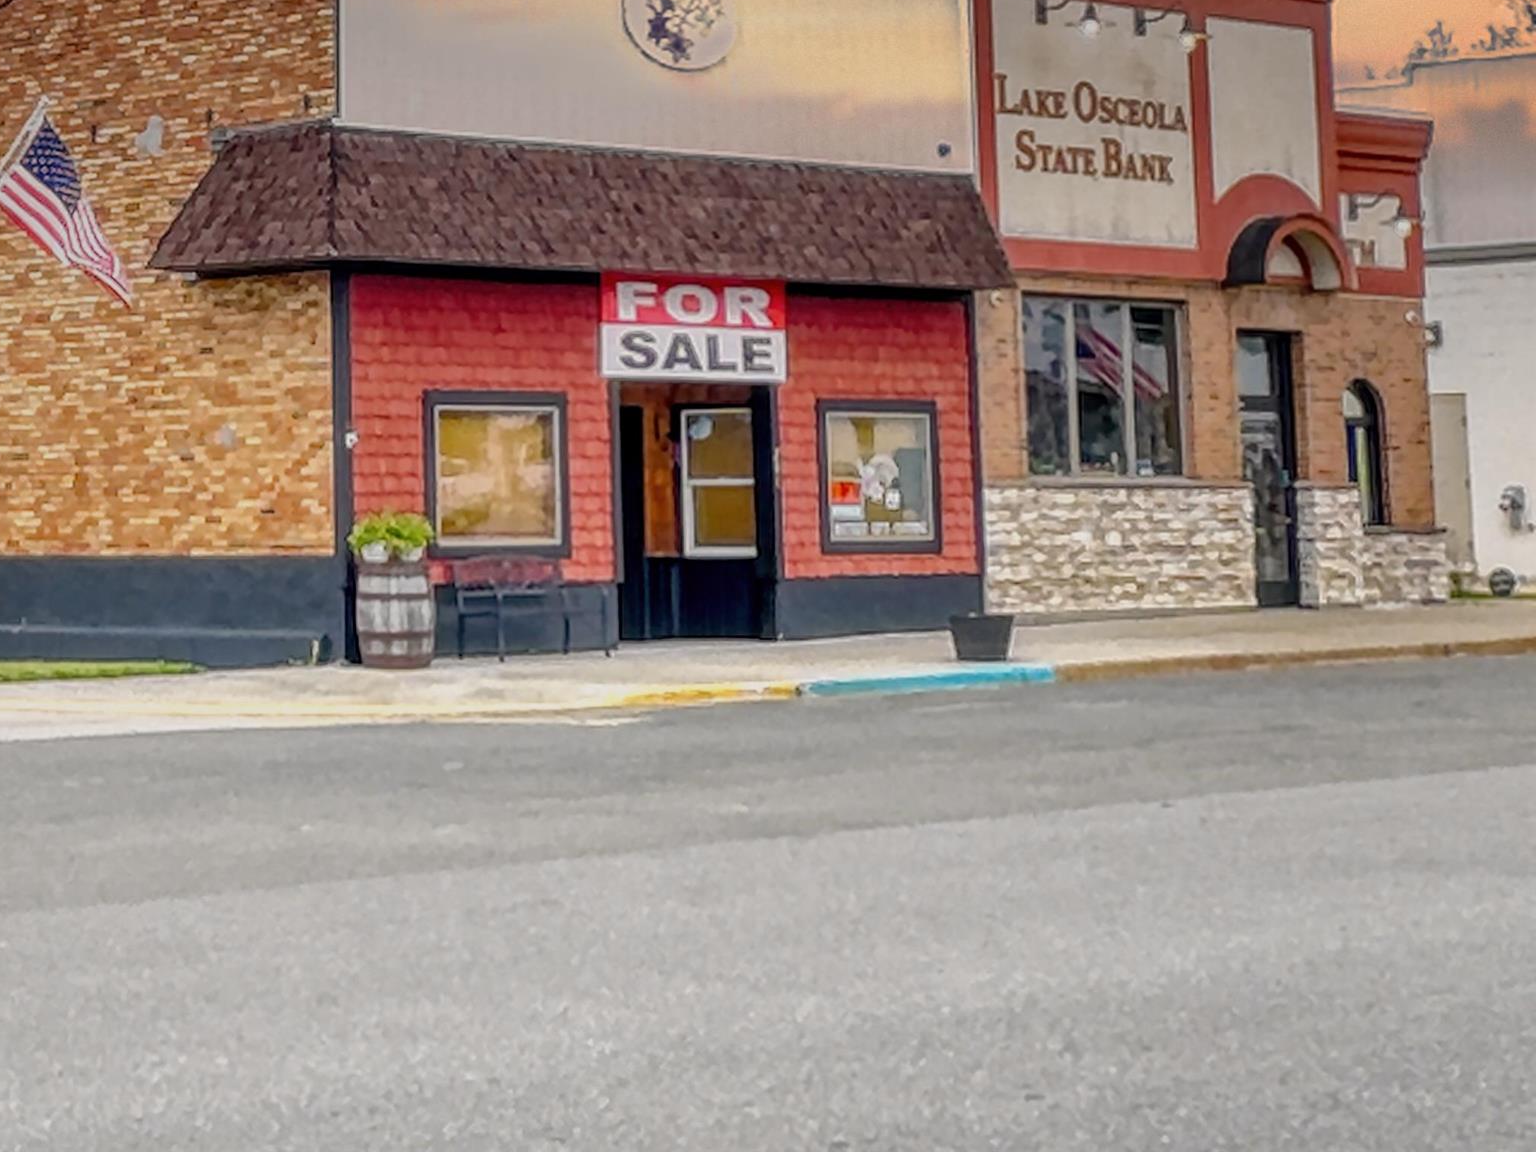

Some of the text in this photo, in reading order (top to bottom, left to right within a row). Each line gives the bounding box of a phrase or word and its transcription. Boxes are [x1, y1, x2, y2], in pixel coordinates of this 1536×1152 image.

[993, 74, 1188, 133] LAKE OSCEOLA
[1015, 130, 1174, 185] STATE BANK
[616, 281, 774, 328] FOR
[619, 330, 775, 372] SALE
